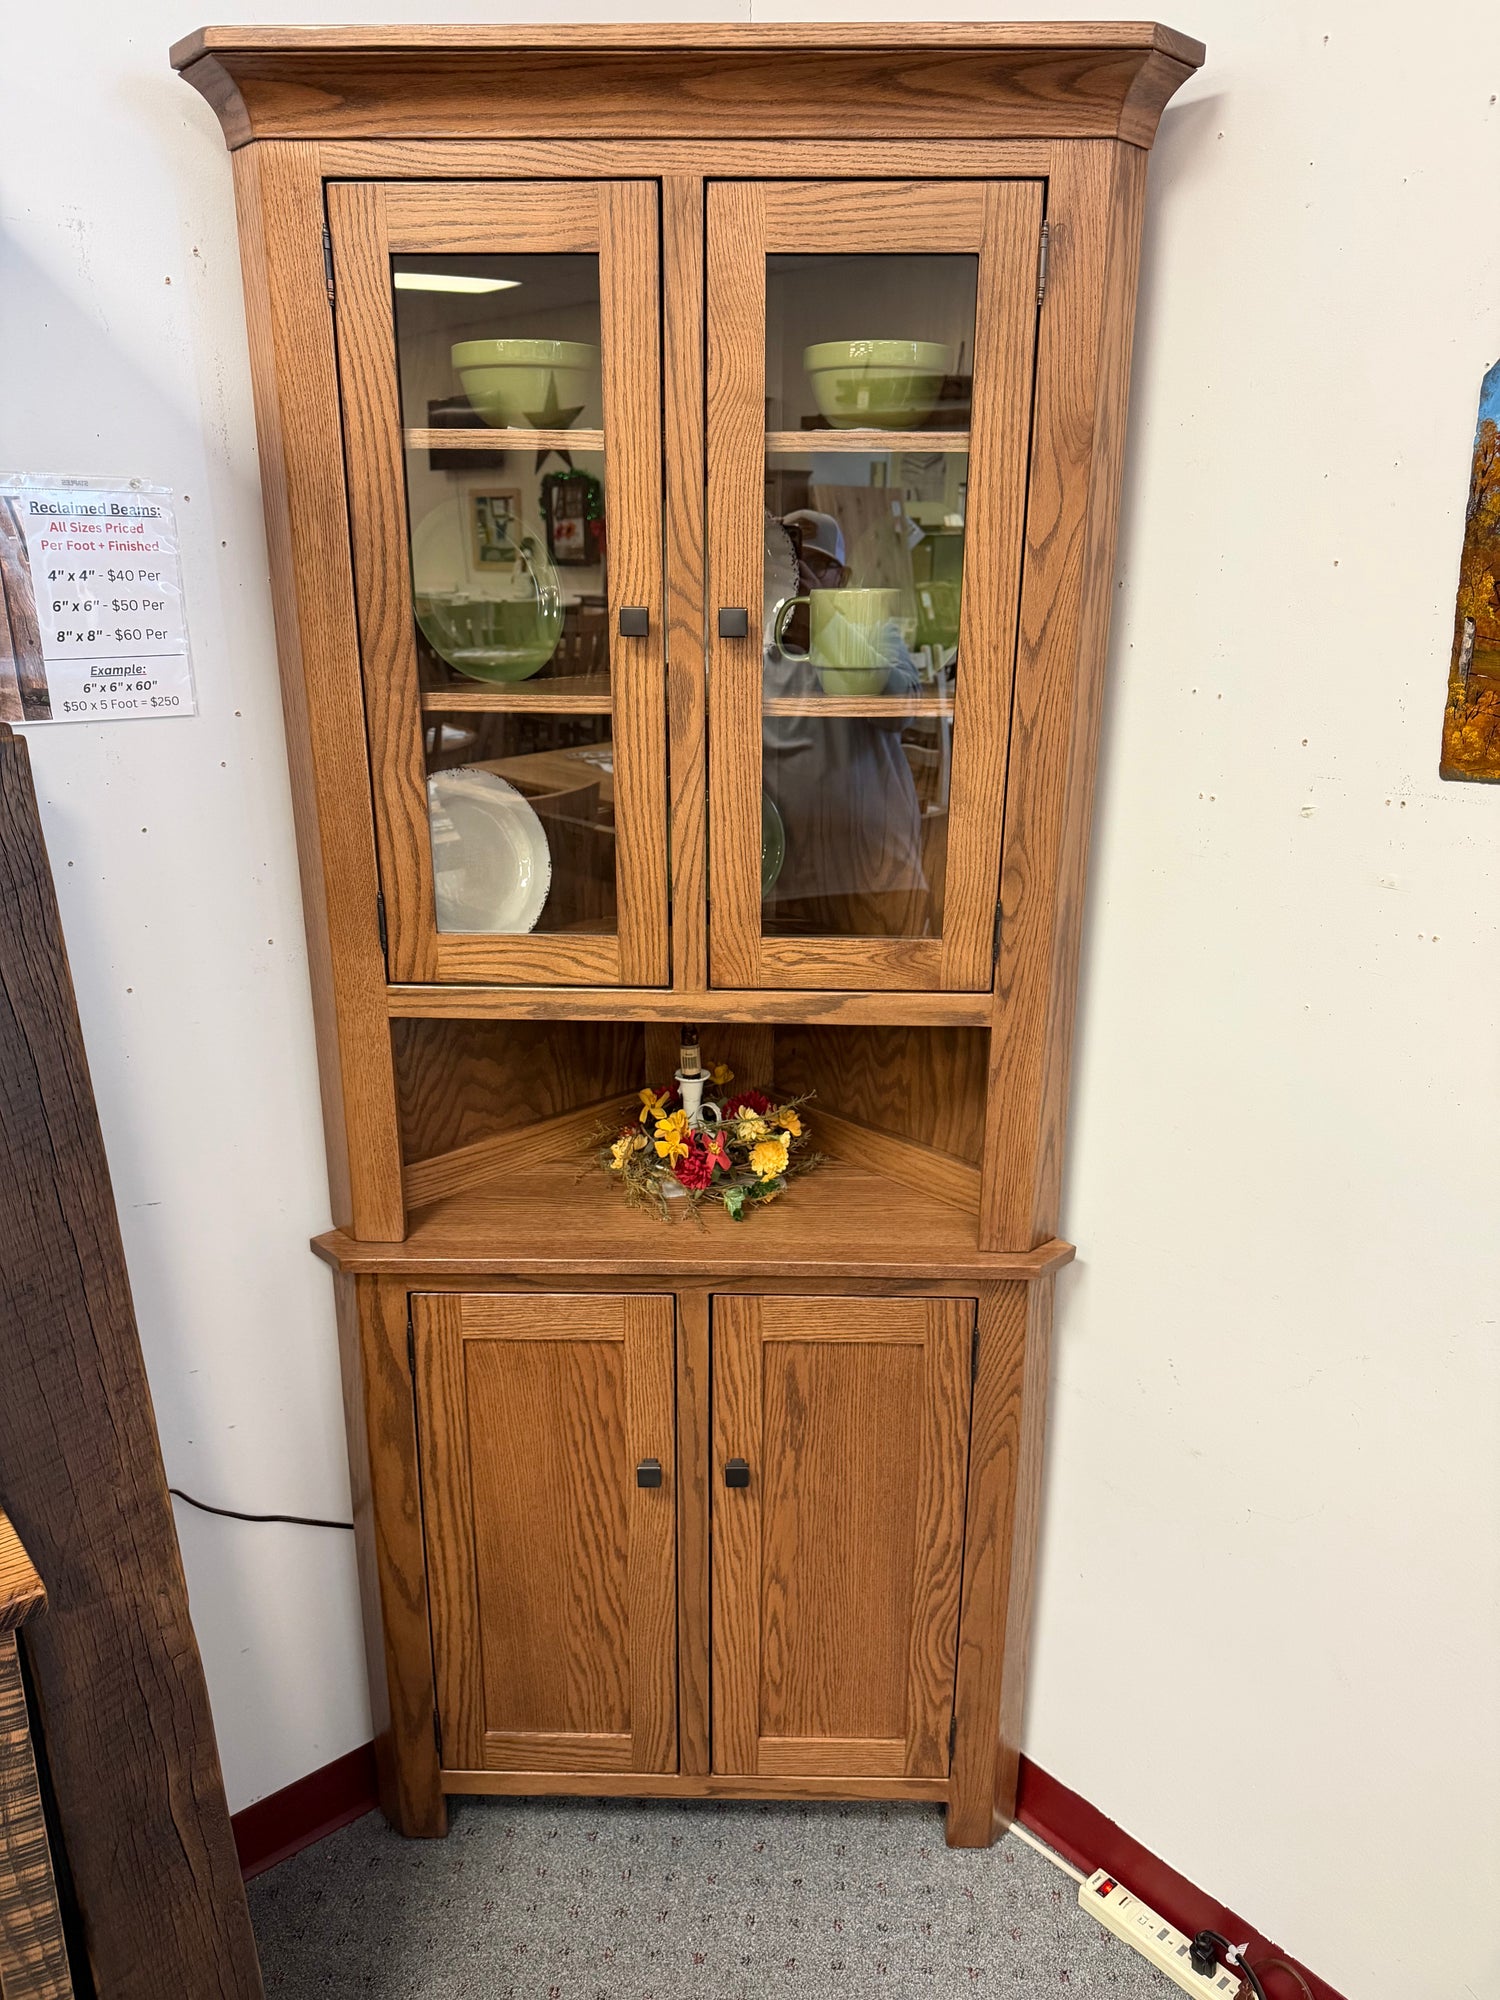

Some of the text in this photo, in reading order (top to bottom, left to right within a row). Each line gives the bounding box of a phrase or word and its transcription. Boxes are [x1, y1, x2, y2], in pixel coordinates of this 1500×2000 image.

[29, 501, 162, 517] Reclaimed Beams:
[49, 521, 145, 534] All Sizes Priced
[41, 540, 63, 551] Per
[66, 540, 95, 551] Foot
[108, 541, 159, 552] Finished
[47, 570, 64, 581] 4"
[67, 572, 76, 581] x
[78, 569, 95, 581] 4"
[107, 569, 135, 582] $40
[138, 570, 161, 582] Per
[52, 600, 69, 612] 6"
[71, 603, 80, 612] x
[83, 600, 100, 611] 6"
[111, 599, 139, 612] $50
[143, 599, 165, 611] Per
[56, 631, 73, 642] 8"
[75, 633, 84, 642] x
[87, 630, 103, 641] 8"
[115, 628, 142, 641] $60
[146, 628, 168, 640] Per
[90, 664, 146, 677] Example:
[83, 683, 97, 693] 6"
[109, 682, 123, 692] 6"
[135, 680, 158, 691] 60"
[63, 700, 87, 712] $50
[100, 700, 108, 710] 5
[111, 698, 138, 709] Foot
[150, 696, 180, 708] $250
